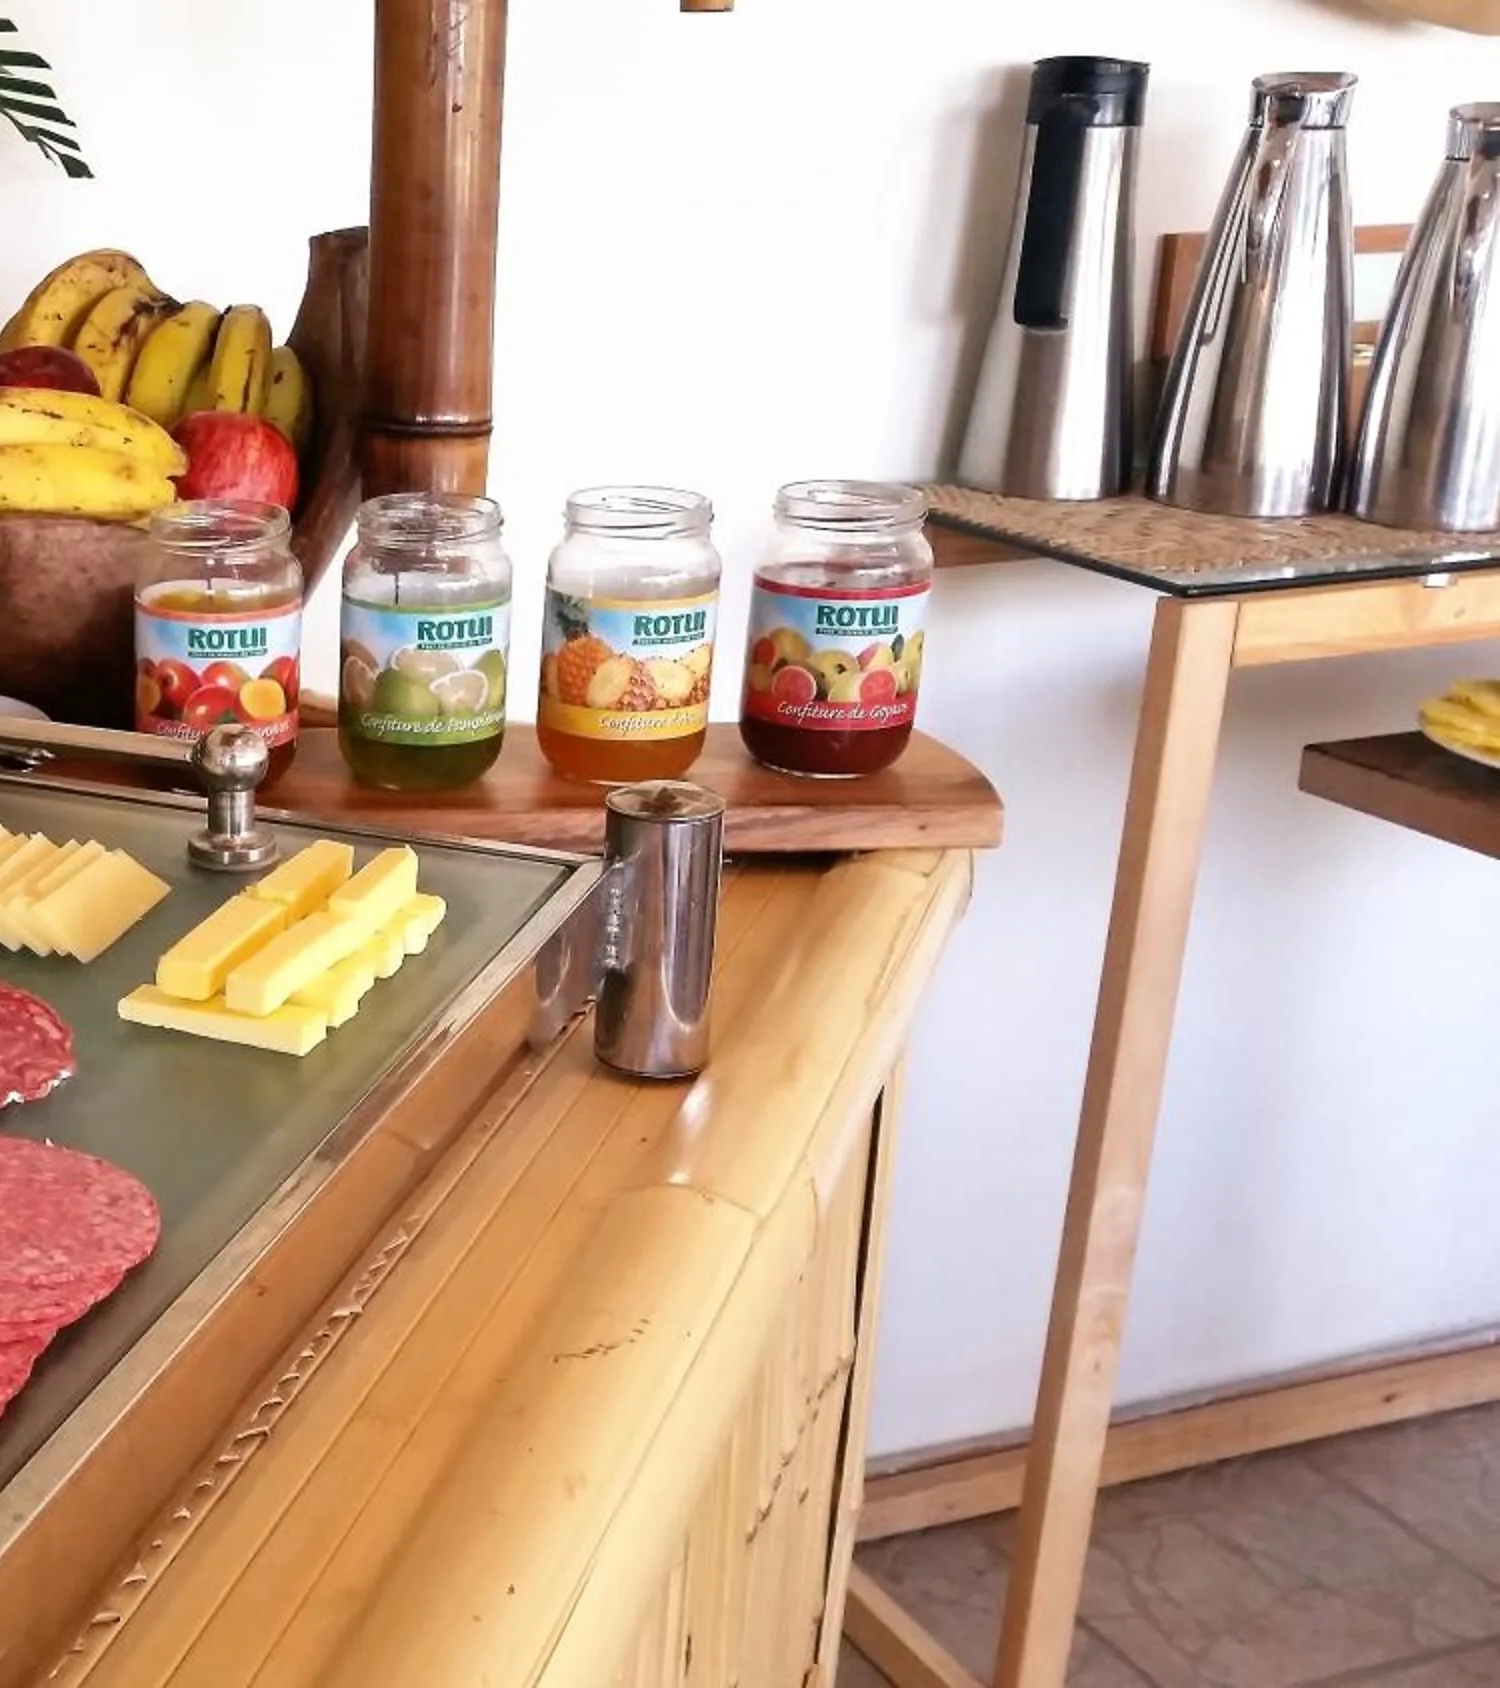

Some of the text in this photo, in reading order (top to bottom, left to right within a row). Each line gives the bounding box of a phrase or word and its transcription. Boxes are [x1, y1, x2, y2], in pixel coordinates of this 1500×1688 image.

[633, 611, 706, 637] ROTUI
[816, 604, 899, 627] ROTUI
[187, 627, 267, 649] ROTUI
[416, 615, 493, 642] ROTUI
